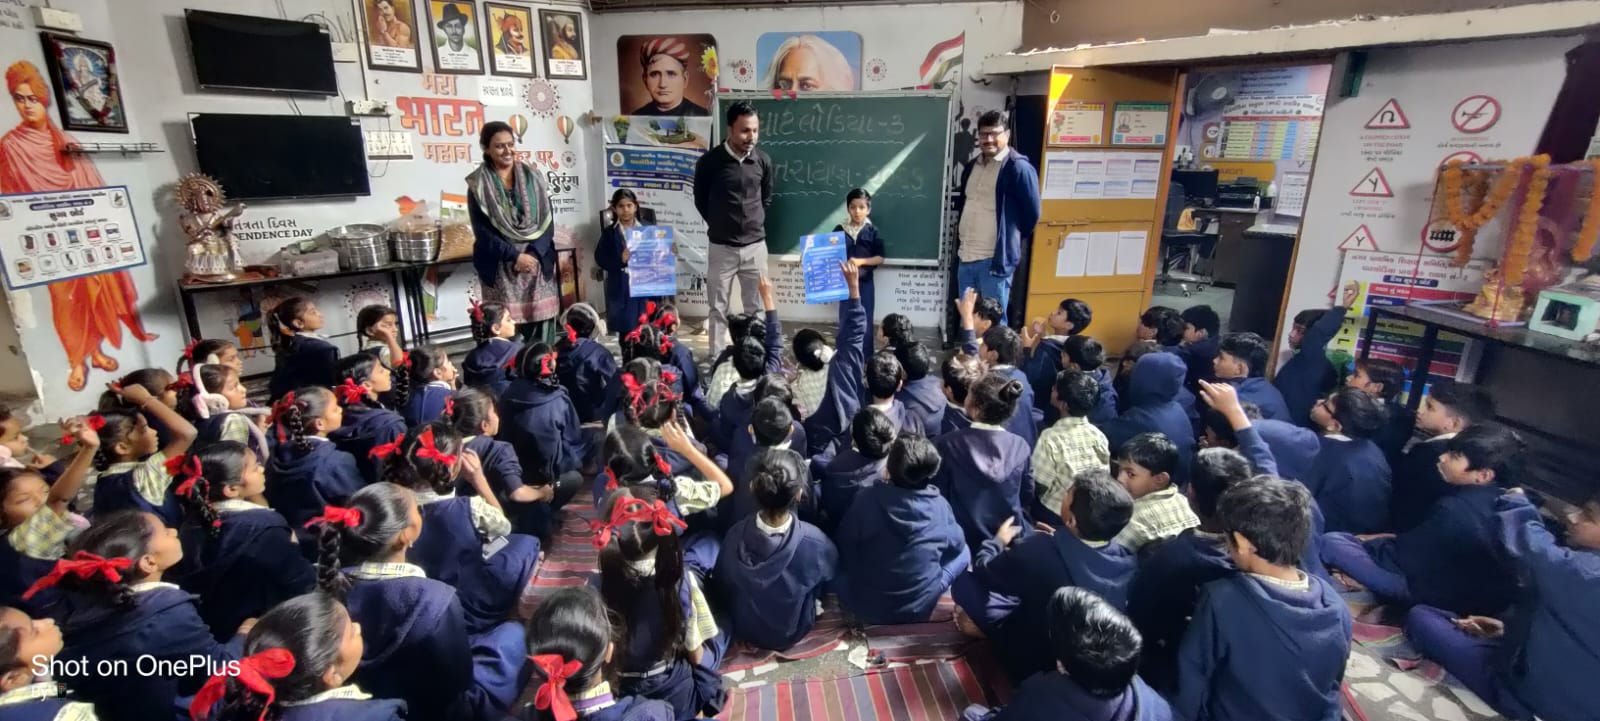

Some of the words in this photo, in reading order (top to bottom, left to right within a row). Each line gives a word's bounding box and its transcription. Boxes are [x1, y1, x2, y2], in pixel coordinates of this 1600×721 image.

[396, 96, 485, 136] भारत
[423, 142, 472, 163] महान
[547, 171, 580, 193] तिरंगा
[234, 218, 264, 231] તંત્રતા
[267, 216, 298, 229] દિવસ
[239, 231, 291, 241] ENDENCE
[292, 229, 313, 238] DAY
